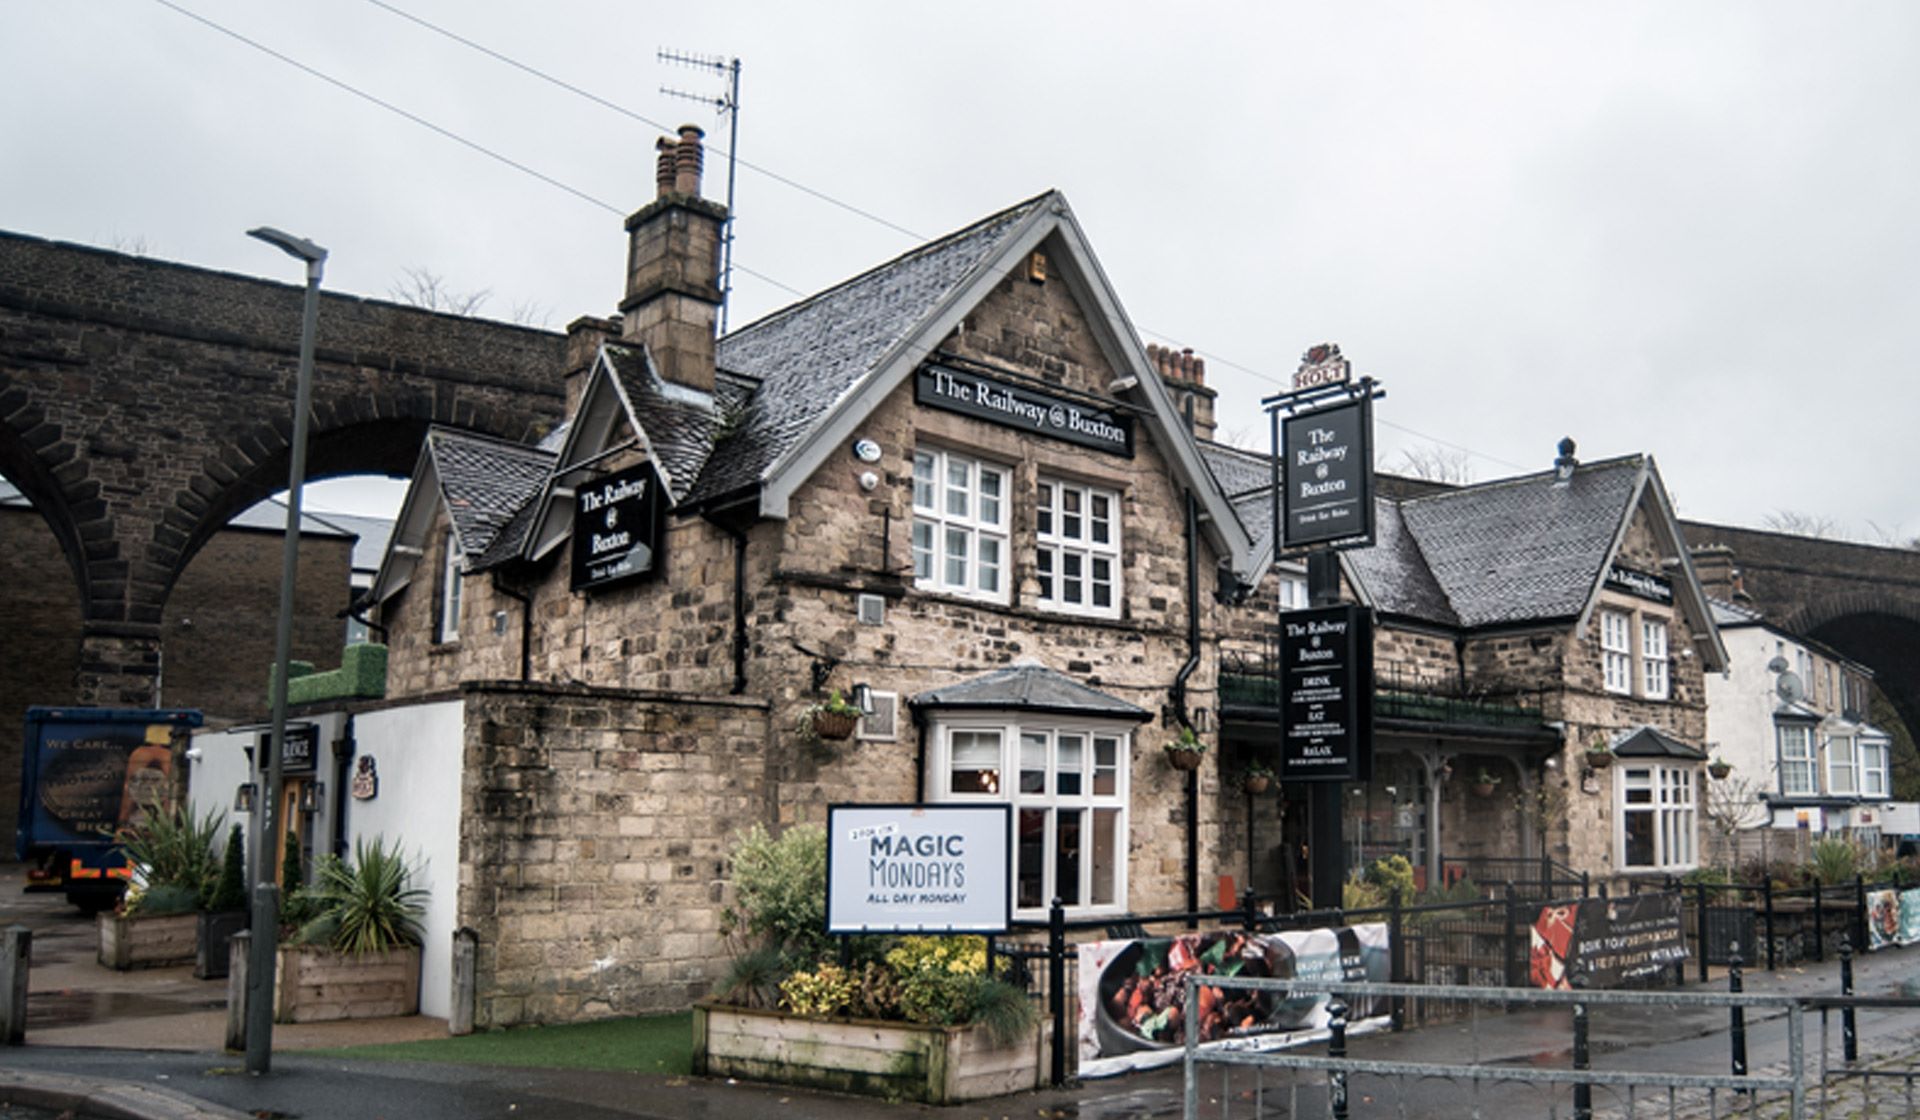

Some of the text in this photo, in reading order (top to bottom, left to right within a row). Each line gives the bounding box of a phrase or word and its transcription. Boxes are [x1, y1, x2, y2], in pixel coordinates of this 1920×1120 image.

[1295, 365, 1343, 389] HOLT
[929, 369, 1126, 443] The Railway @ Buxton
[1308, 428, 1335, 445] The
[1297, 445, 1348, 467] Railway
[581, 480, 647, 513] The Railway
[1300, 479, 1346, 498] Buxton
[1286, 621, 1347, 637] The Railway
[1302, 675, 1331, 687] DRINK
[870, 835, 964, 857] MAGIC
[869, 858, 965, 888] MONDAYS
[866, 893, 967, 904] ALL DAY MONDAY
